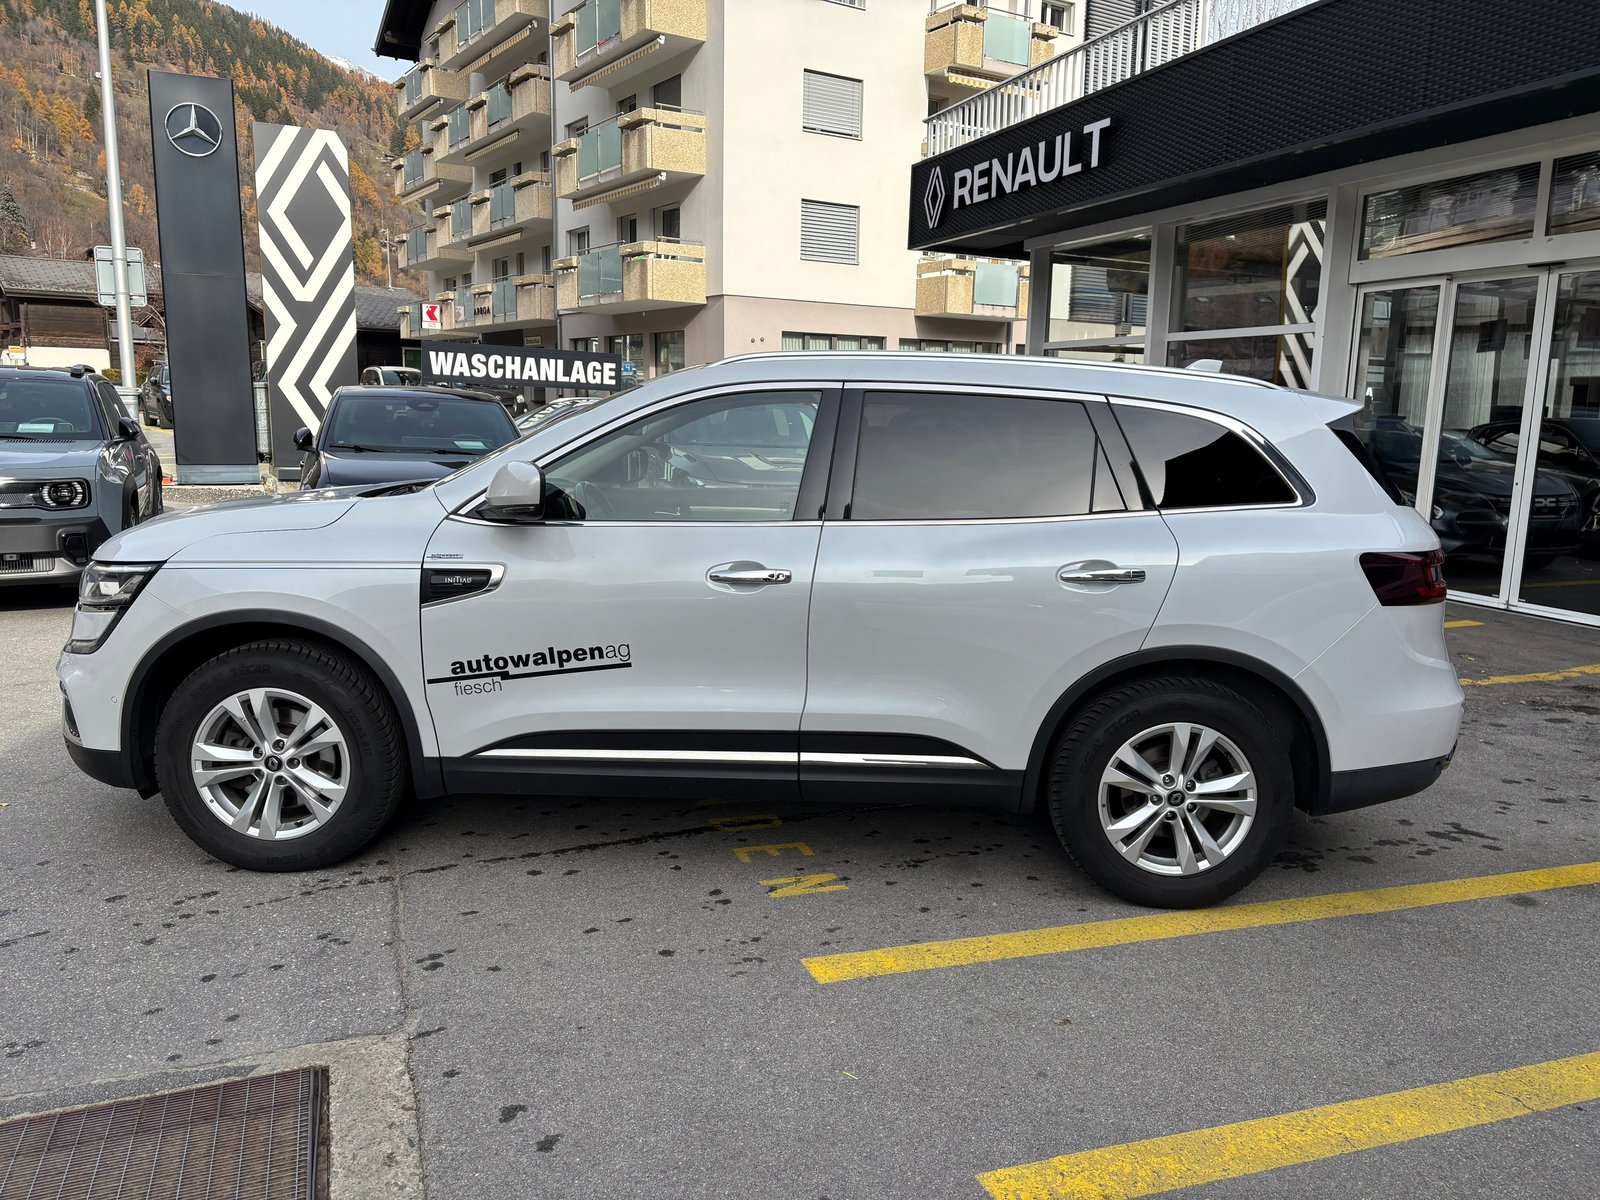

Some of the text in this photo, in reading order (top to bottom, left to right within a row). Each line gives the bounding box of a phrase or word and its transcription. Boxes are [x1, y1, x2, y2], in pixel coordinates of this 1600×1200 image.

[953, 117, 1111, 209] RENAULT
[429, 350, 617, 386] WASCHANLAGE
[454, 679, 503, 696] fiesch
